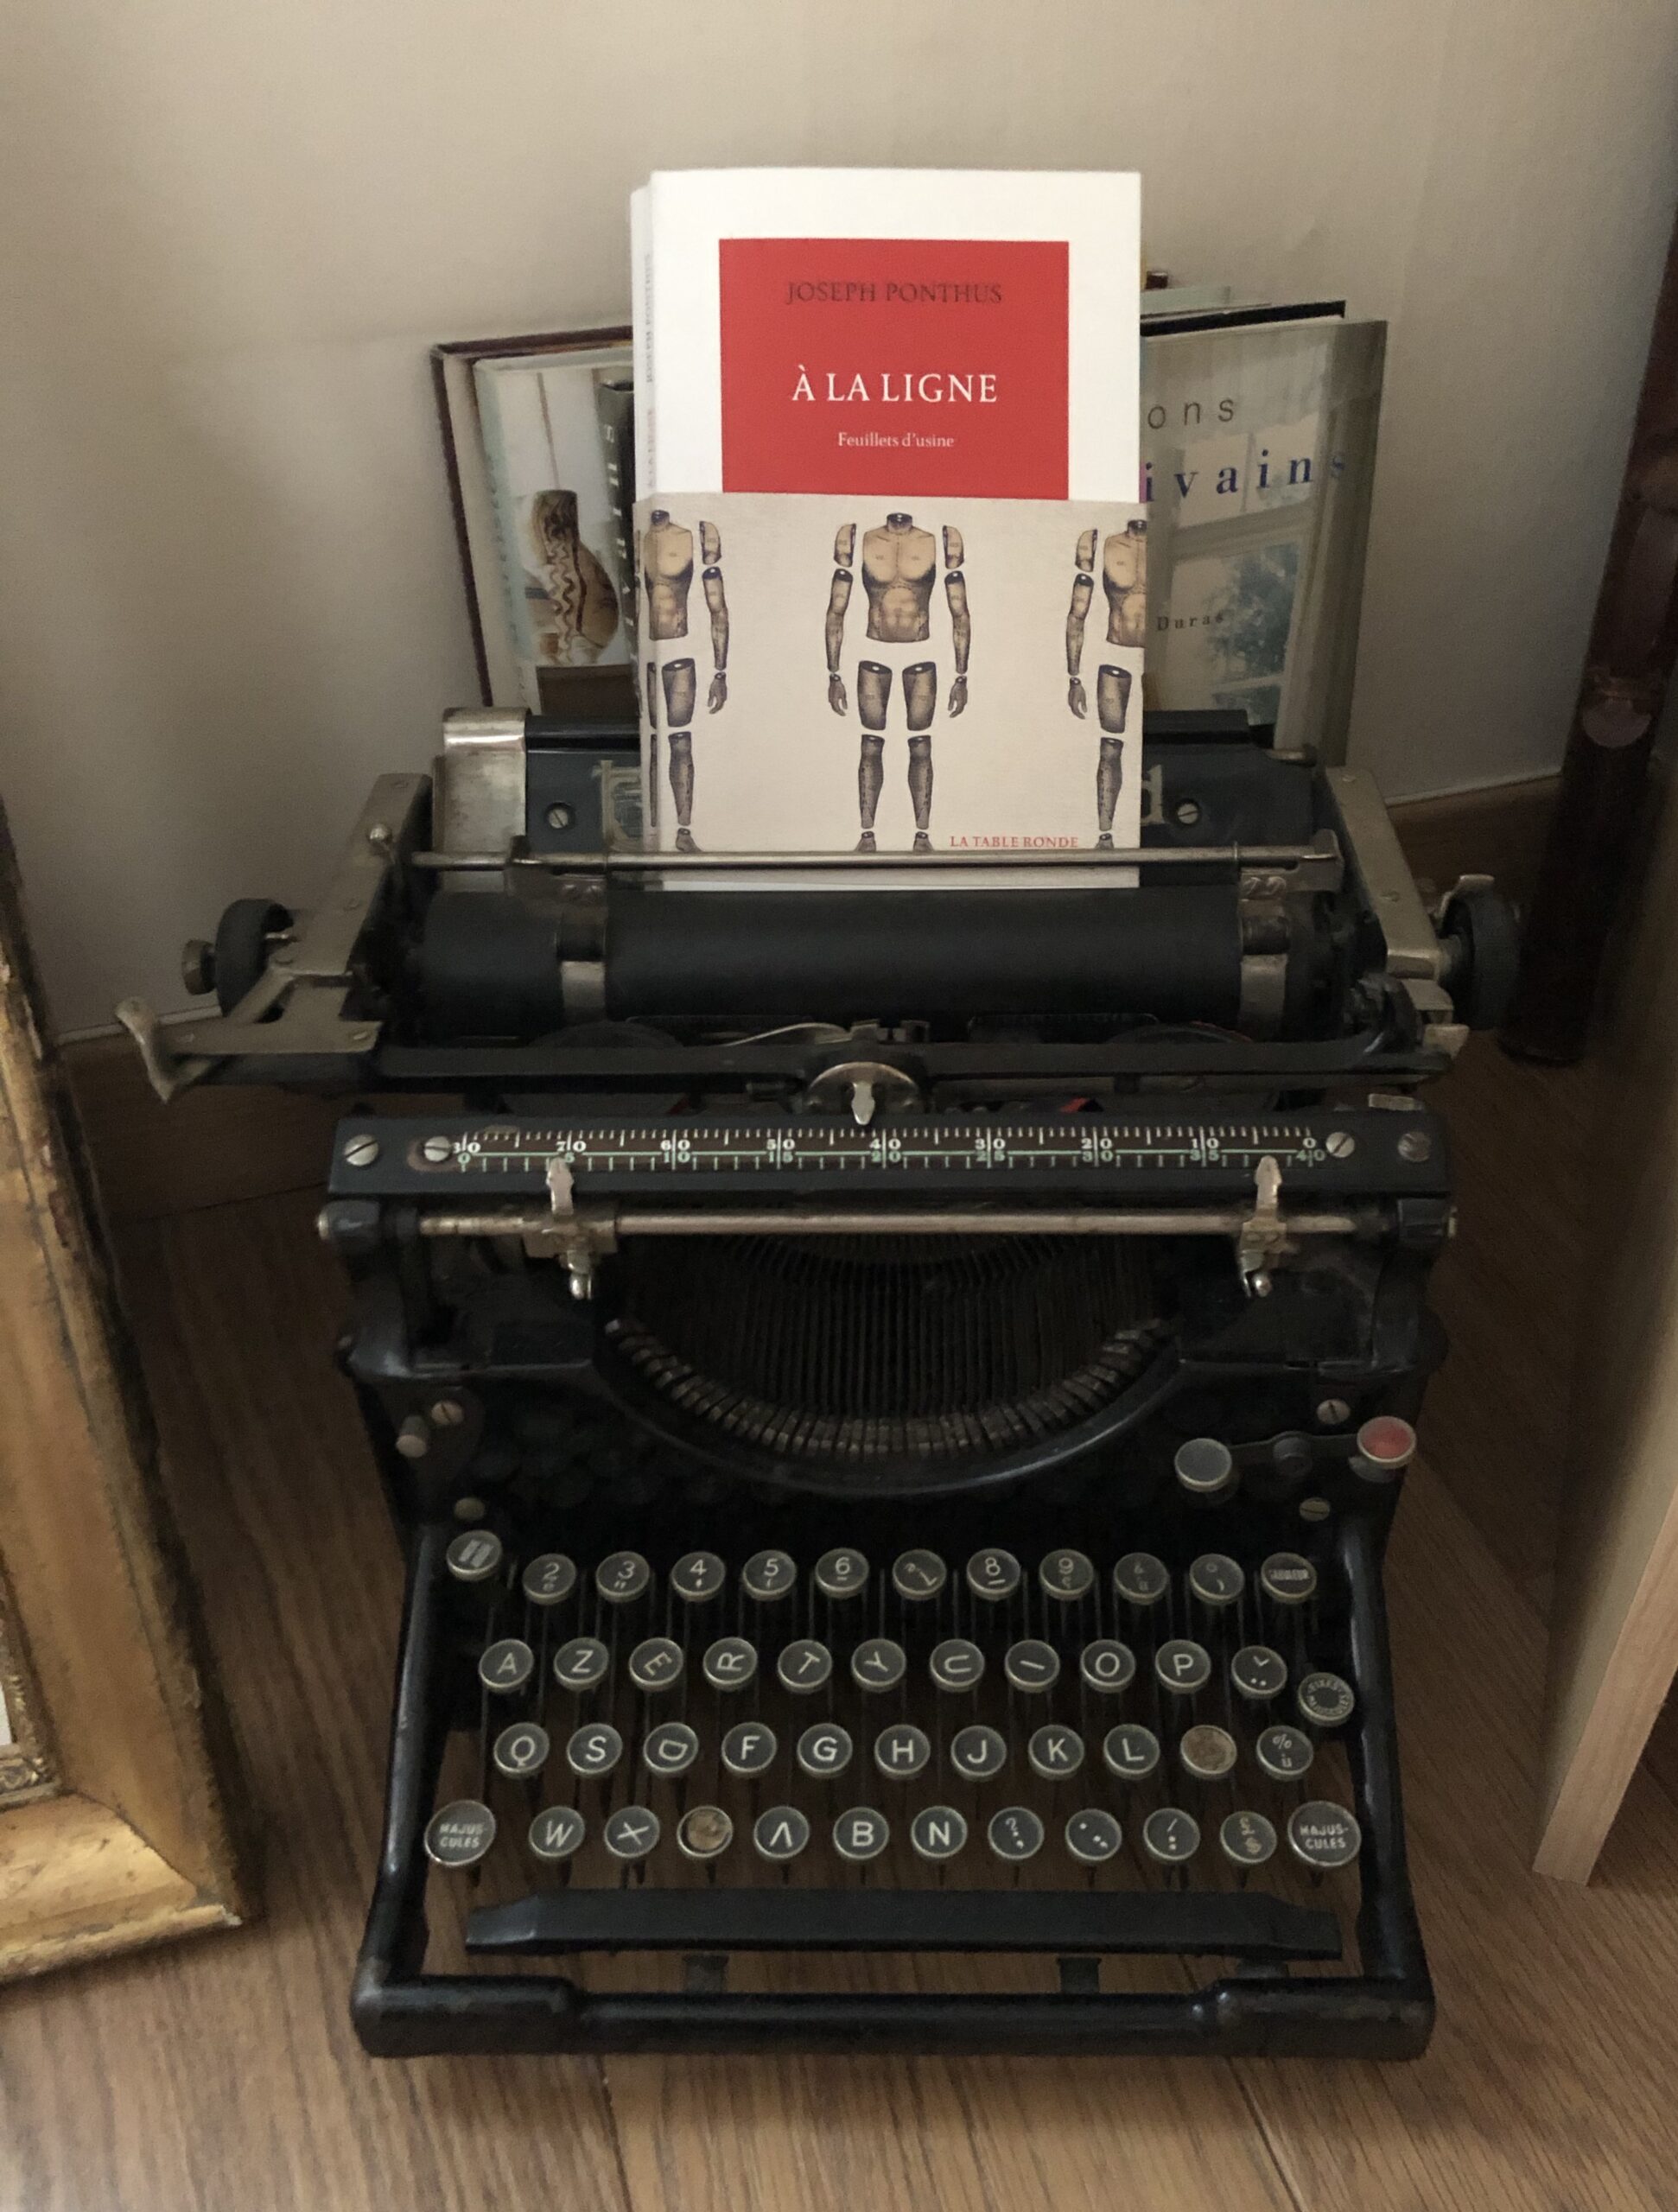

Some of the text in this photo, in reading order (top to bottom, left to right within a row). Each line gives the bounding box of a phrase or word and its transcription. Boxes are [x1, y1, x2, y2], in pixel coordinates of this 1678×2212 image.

[786, 282, 1002, 304] JOSEPH PONTHUS
[791, 364, 997, 403] À LA LIGNE
[838, 432, 899, 447] Feuillets
[950, 836, 1078, 849] LA TABLE RONDE
